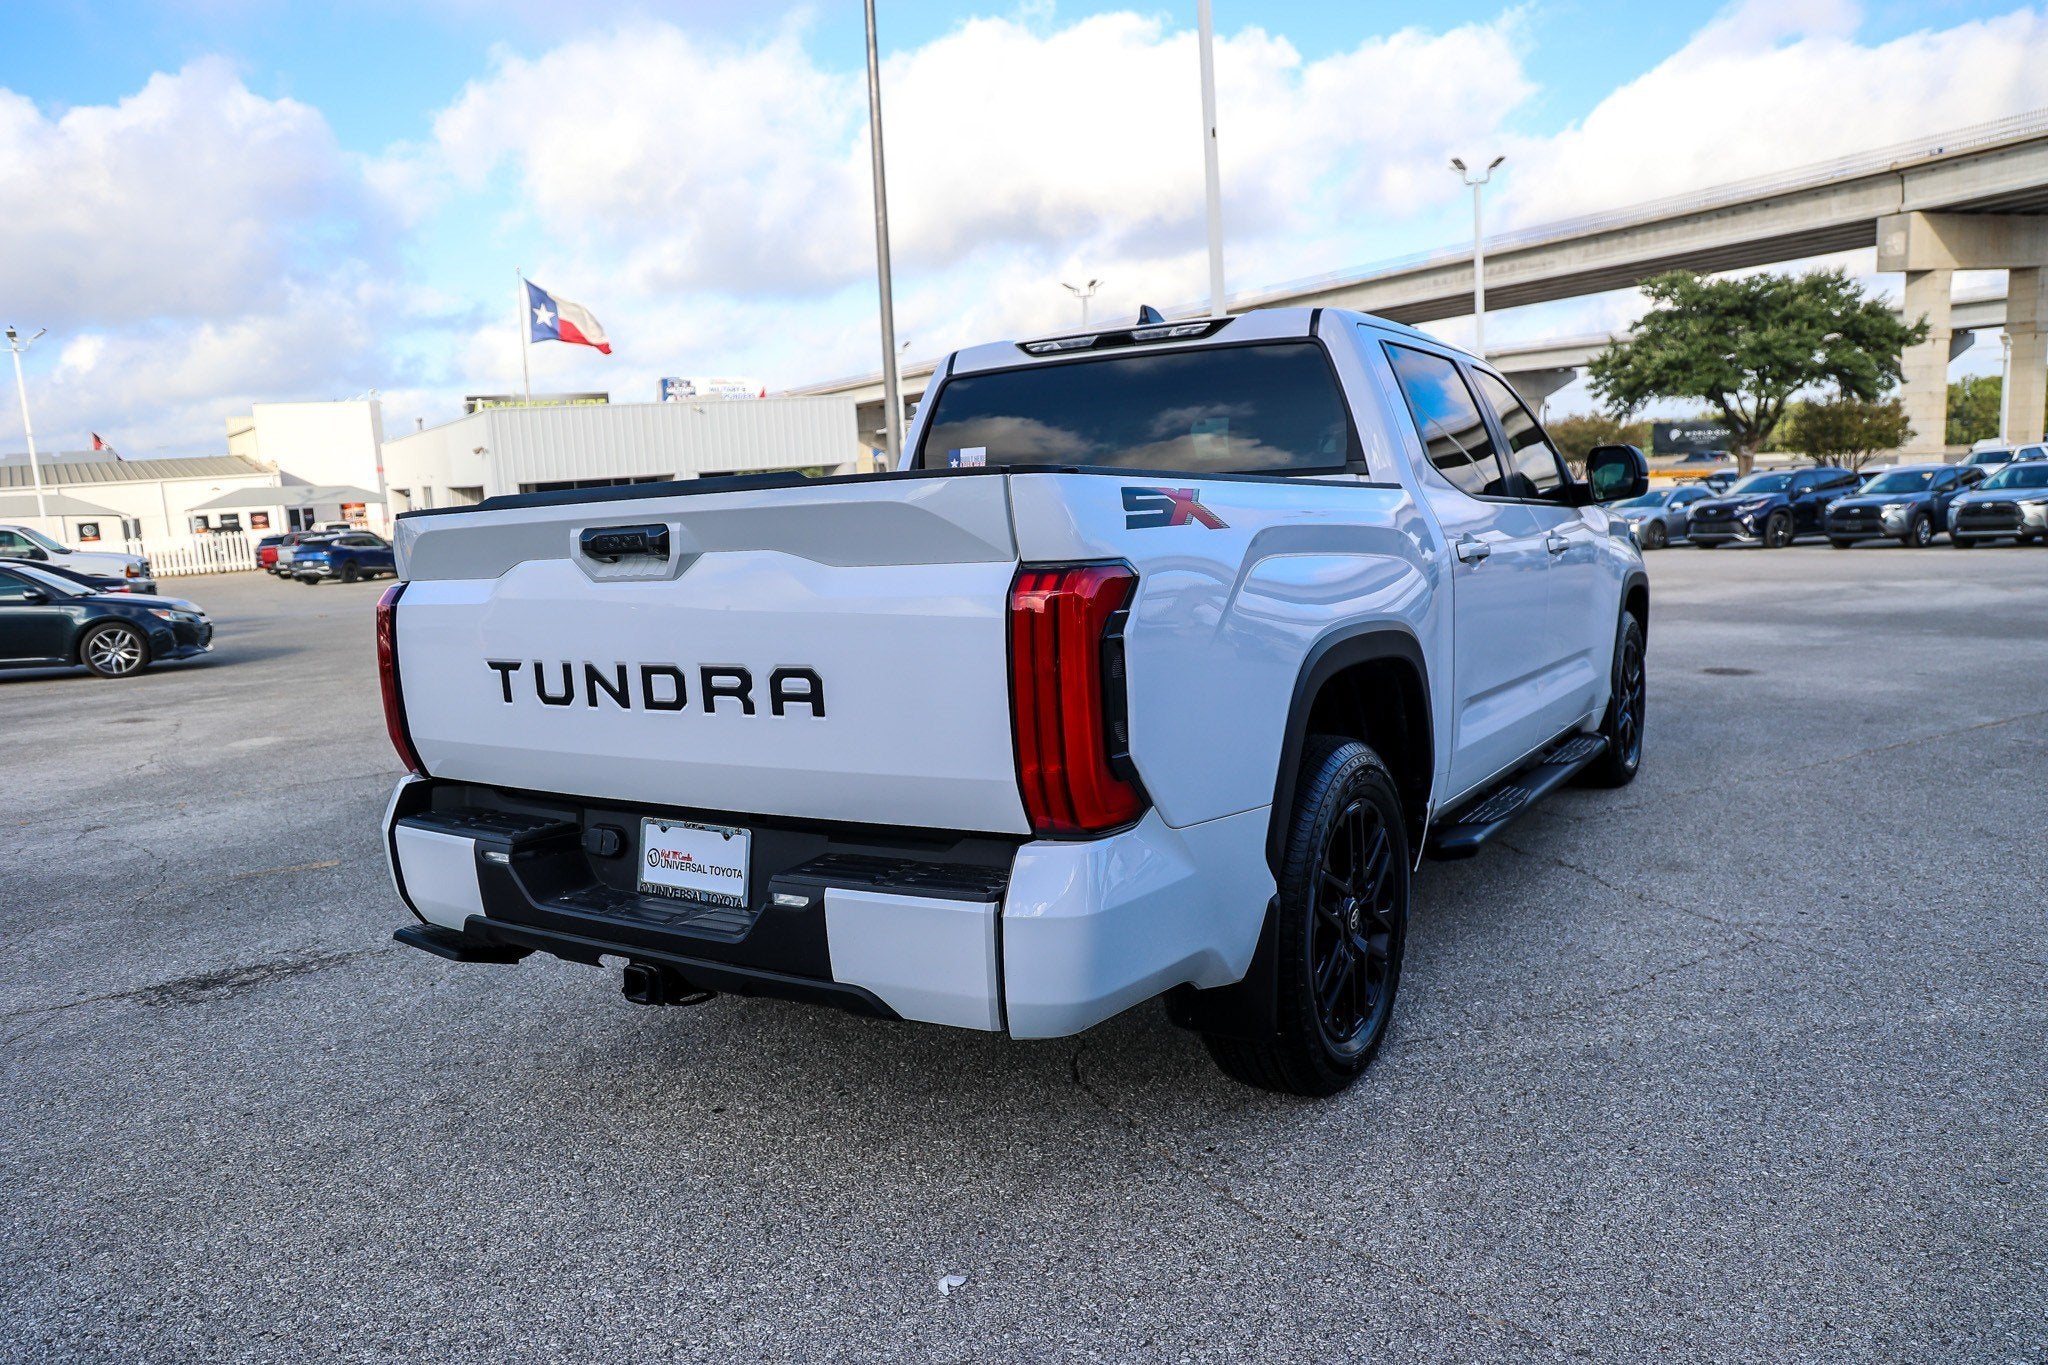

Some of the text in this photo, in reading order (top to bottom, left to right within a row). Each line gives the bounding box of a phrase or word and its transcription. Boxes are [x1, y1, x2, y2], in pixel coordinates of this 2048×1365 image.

[485, 660, 826, 718] TUNDRA
[660, 849, 670, 859] Red
[660, 860, 743, 879] UNIVERSAL TOYOTA
[651, 884, 744, 908] UNIVERSAL TOYOTA
